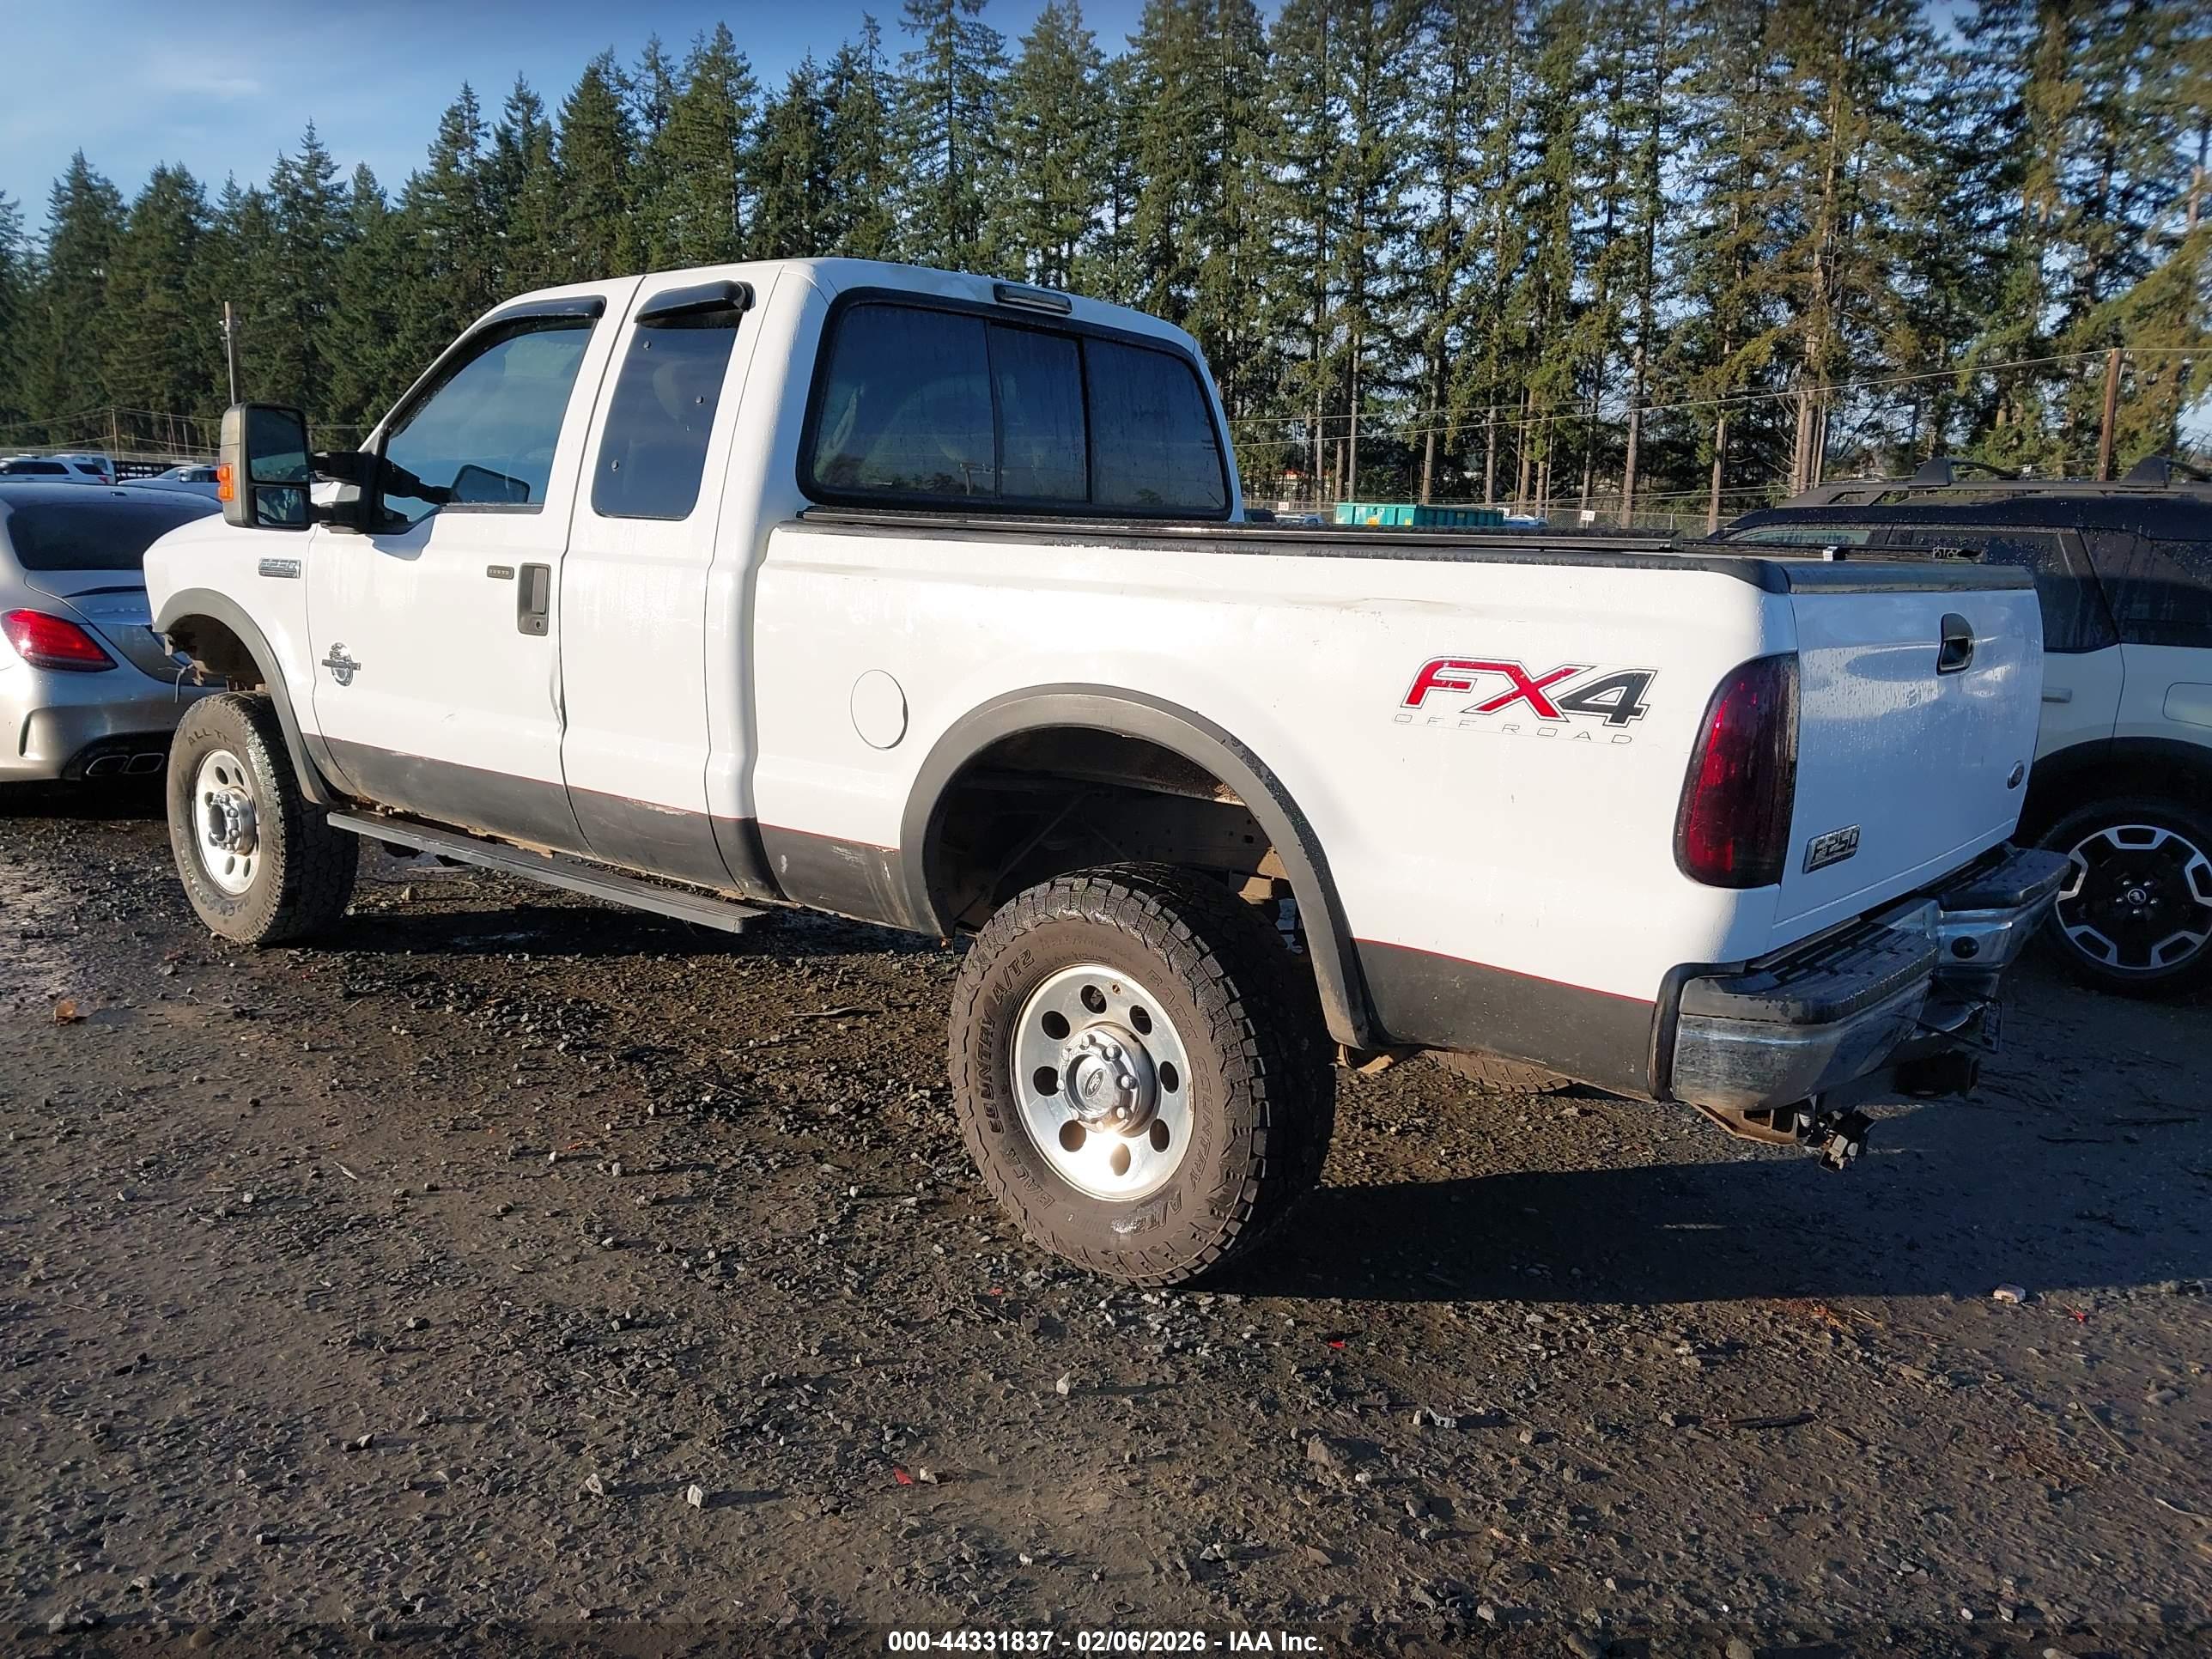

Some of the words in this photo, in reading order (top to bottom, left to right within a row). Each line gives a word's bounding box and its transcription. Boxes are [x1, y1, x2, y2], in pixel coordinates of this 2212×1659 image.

[1401, 656, 1659, 727] FX4
[188, 728, 211, 746] ALL
[1394, 714, 1478, 729] OFF
[1501, 723, 1633, 744] ROAD
[976, 1009, 1005, 1134] COUNTRY
[992, 949, 1035, 1006] A/T2
